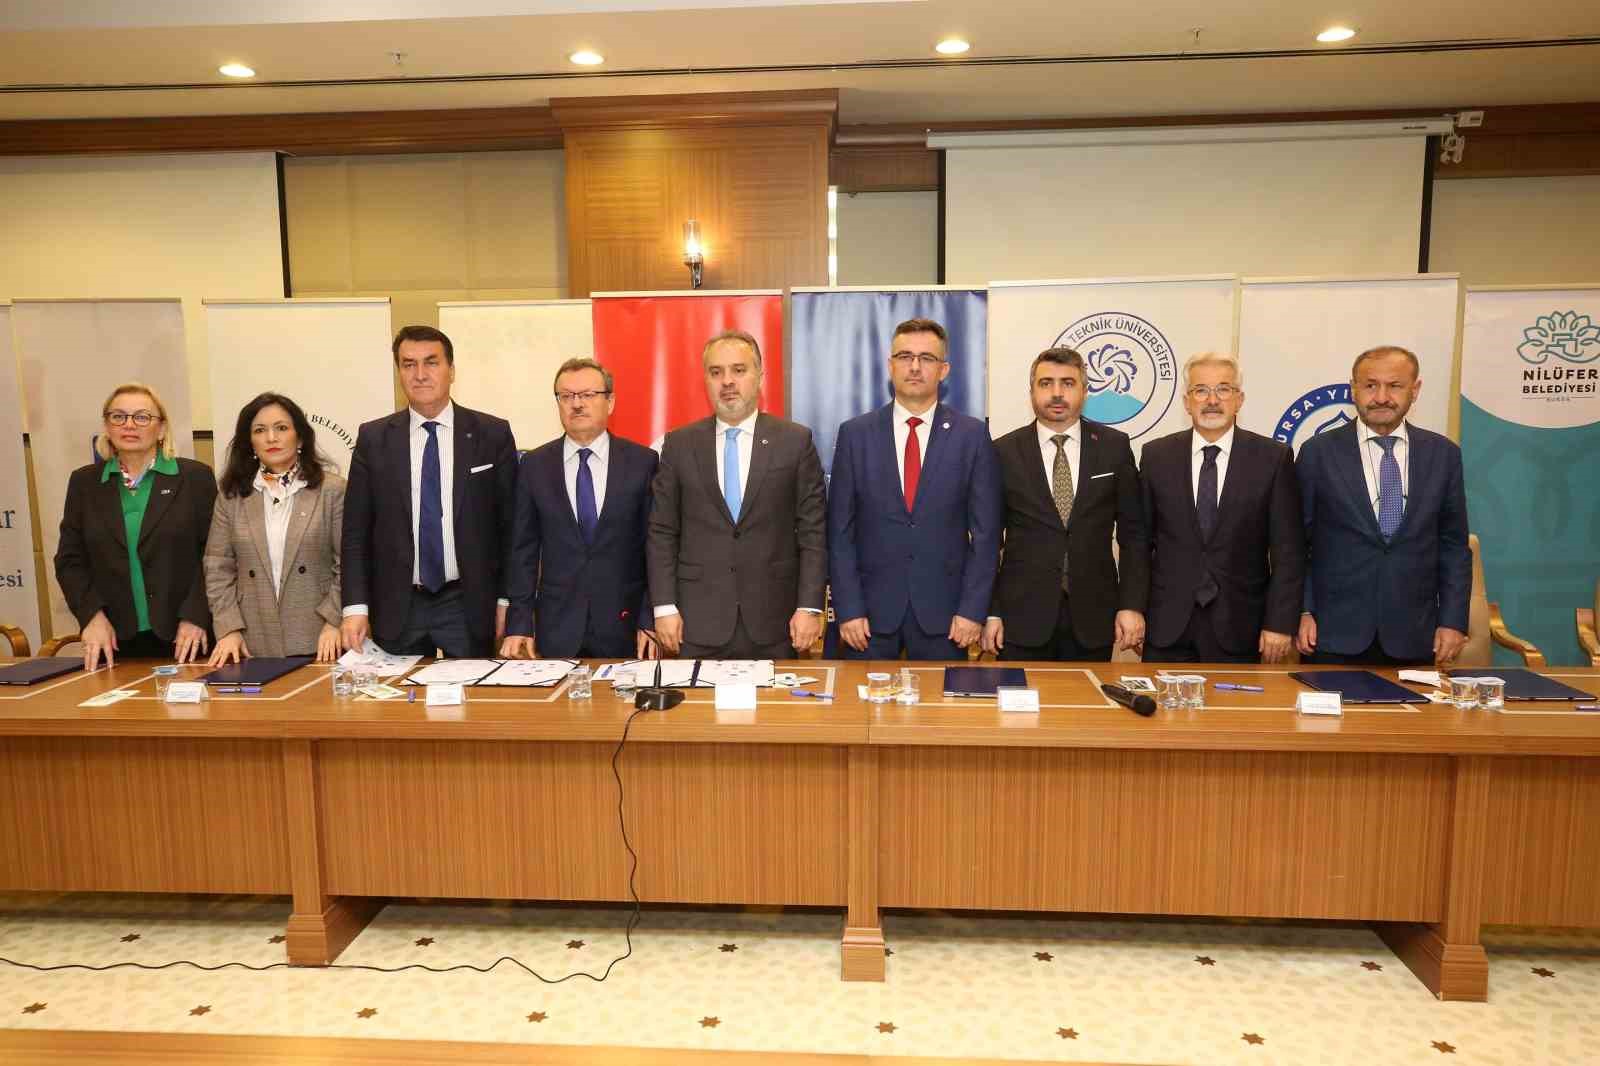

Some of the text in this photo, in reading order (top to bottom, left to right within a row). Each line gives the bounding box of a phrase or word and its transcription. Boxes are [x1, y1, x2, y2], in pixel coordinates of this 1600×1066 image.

[1067, 317, 1173, 381] TEKNİK ÜNİVERSİTESİ
[1523, 366, 1599, 381] NİLÜFER
[1522, 382, 1597, 394] BELEDİYESİ
